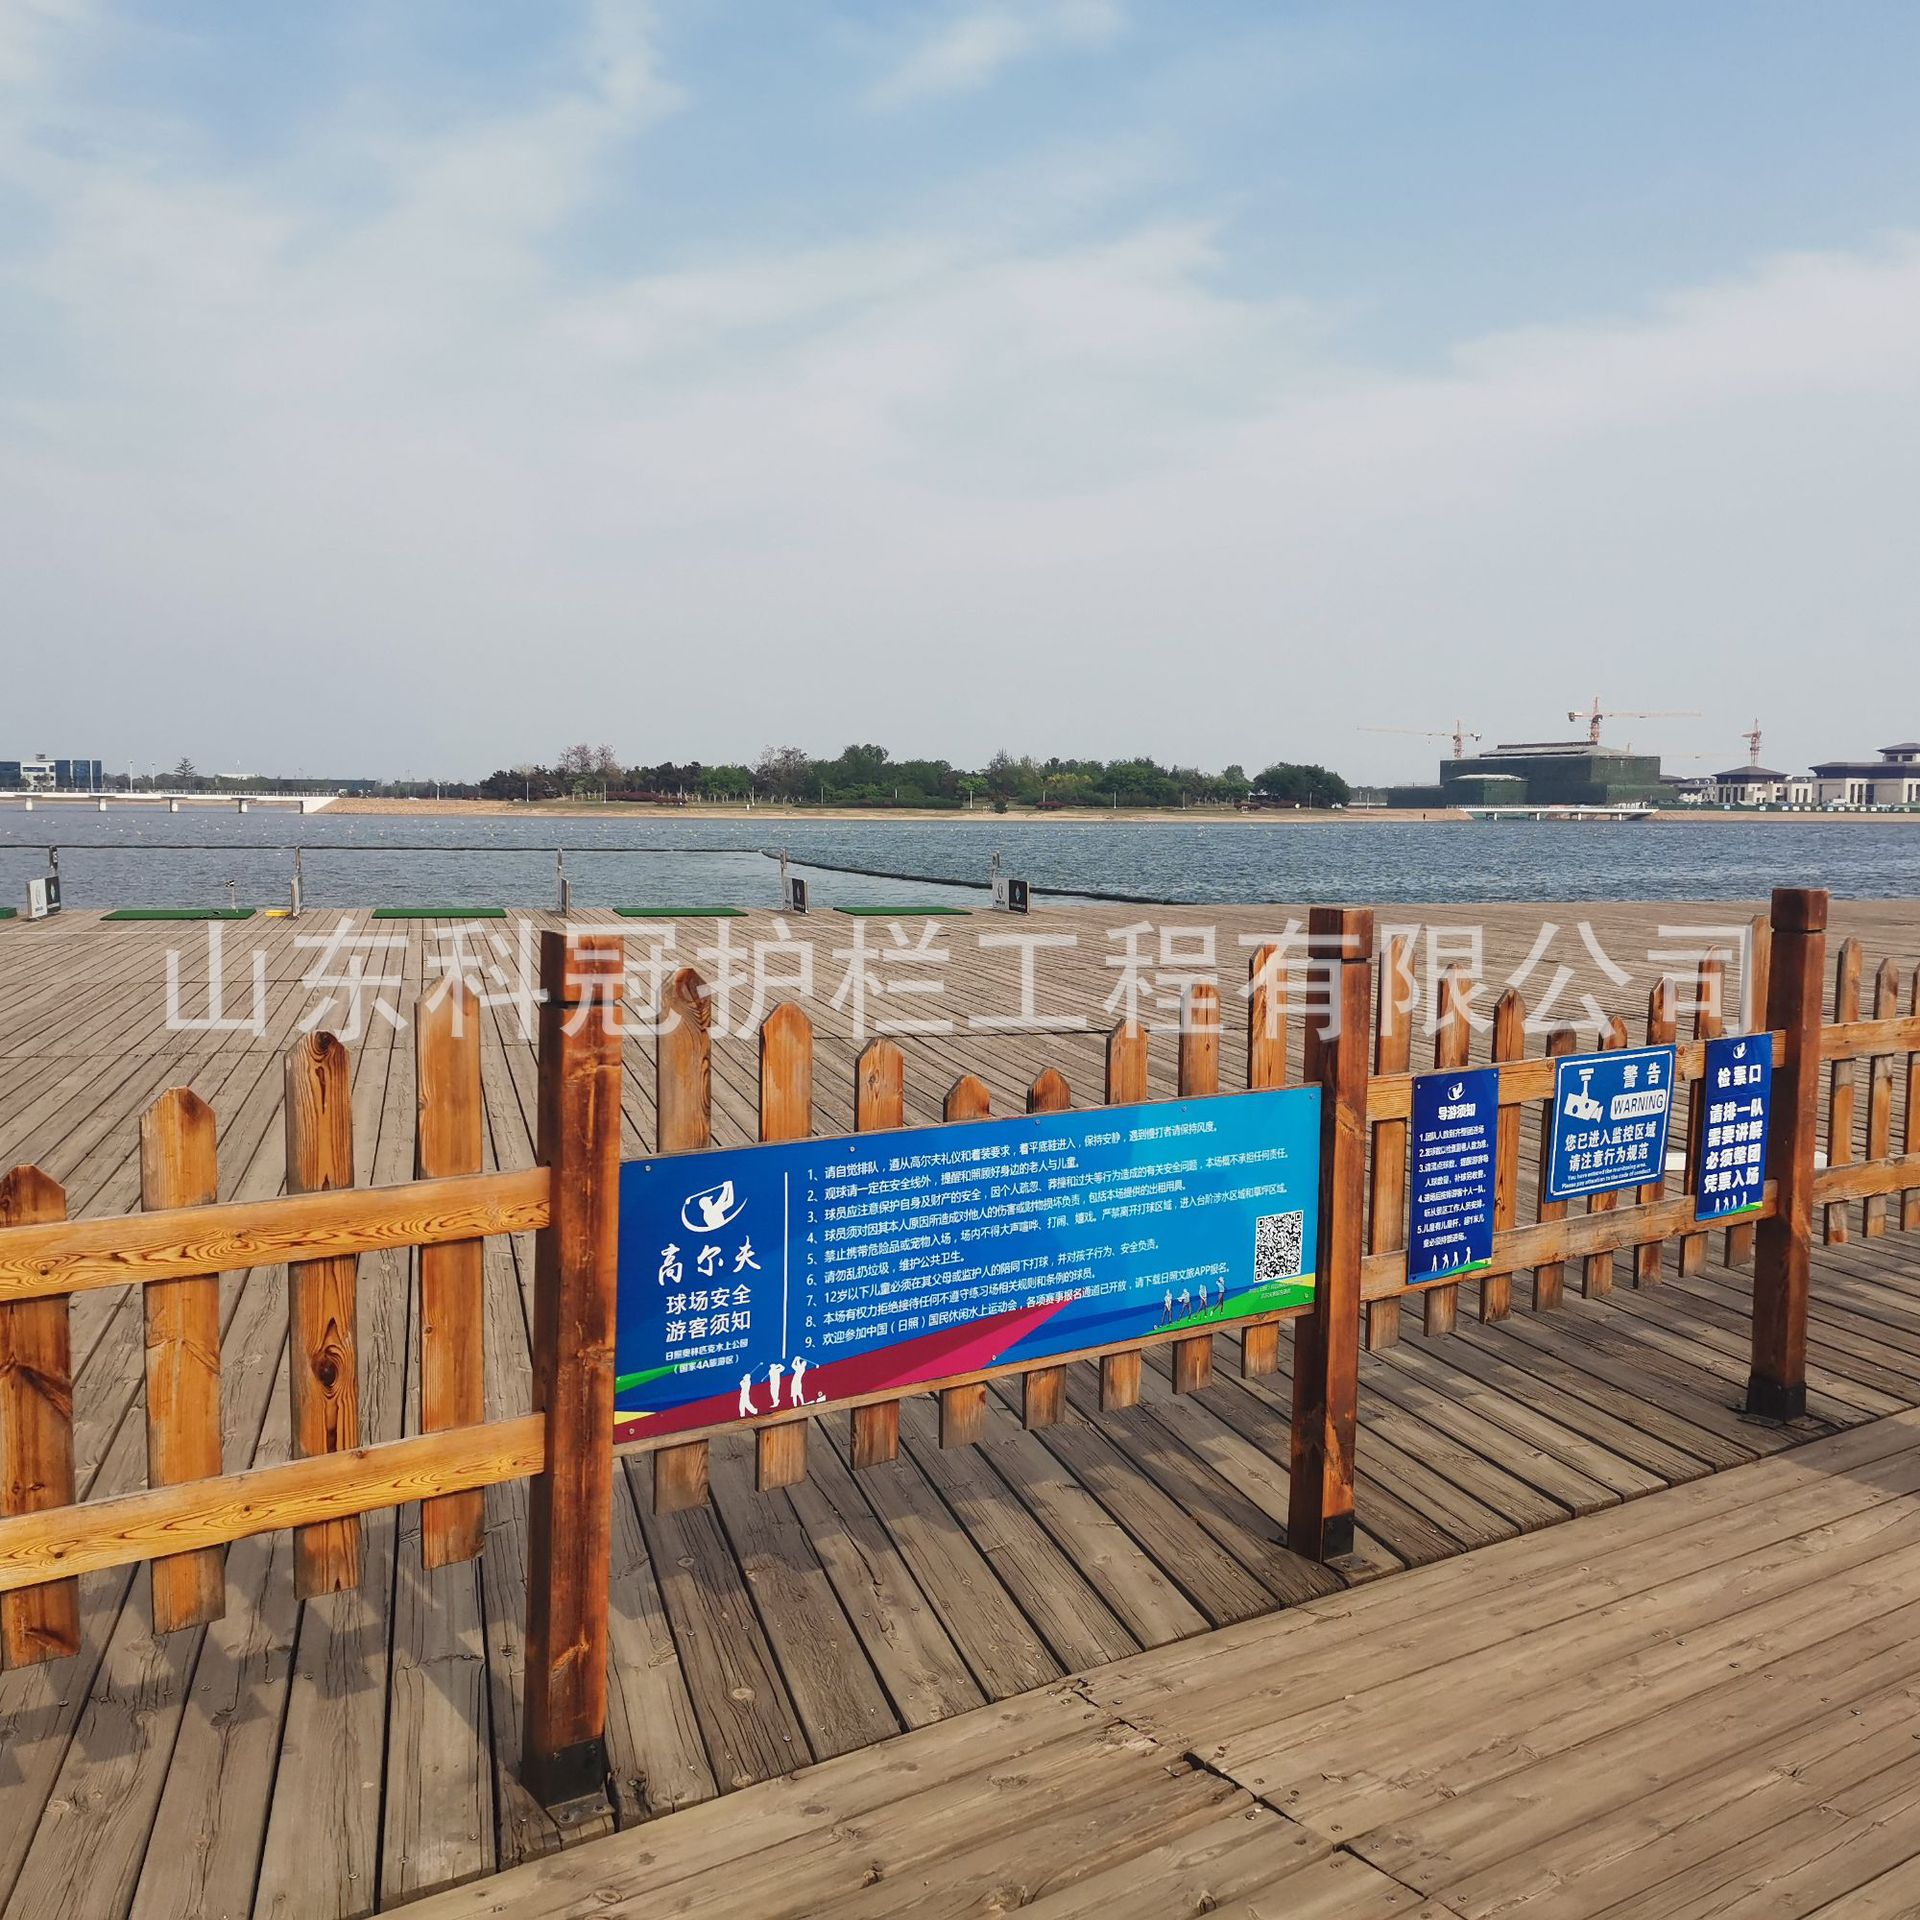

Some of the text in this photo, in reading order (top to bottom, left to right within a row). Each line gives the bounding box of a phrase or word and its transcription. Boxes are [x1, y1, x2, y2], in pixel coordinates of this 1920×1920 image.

[1623, 1062, 1661, 1088] 警告
[1717, 1065, 1761, 1088] 检票口
[1438, 1103, 1476, 1121] 导游须知
[1614, 1094, 1664, 1115] WARNING
[1709, 1097, 1764, 1124] 请排一队
[1565, 1121, 1657, 1152] 您已进入监控区域
[1708, 1120, 1763, 1148] 需要讲解
[1569, 1142, 1649, 1172] 请注意行为规范
[1706, 1143, 1761, 1170] 必须整团
[1704, 1167, 1760, 1194] 凭票入场
[657, 1235, 761, 1286] 高尔夫
[666, 1284, 751, 1315] 球场安全
[665, 1310, 751, 1342] 游客须知
[665, 1338, 749, 1361] 日照奥林匹克水上公园
